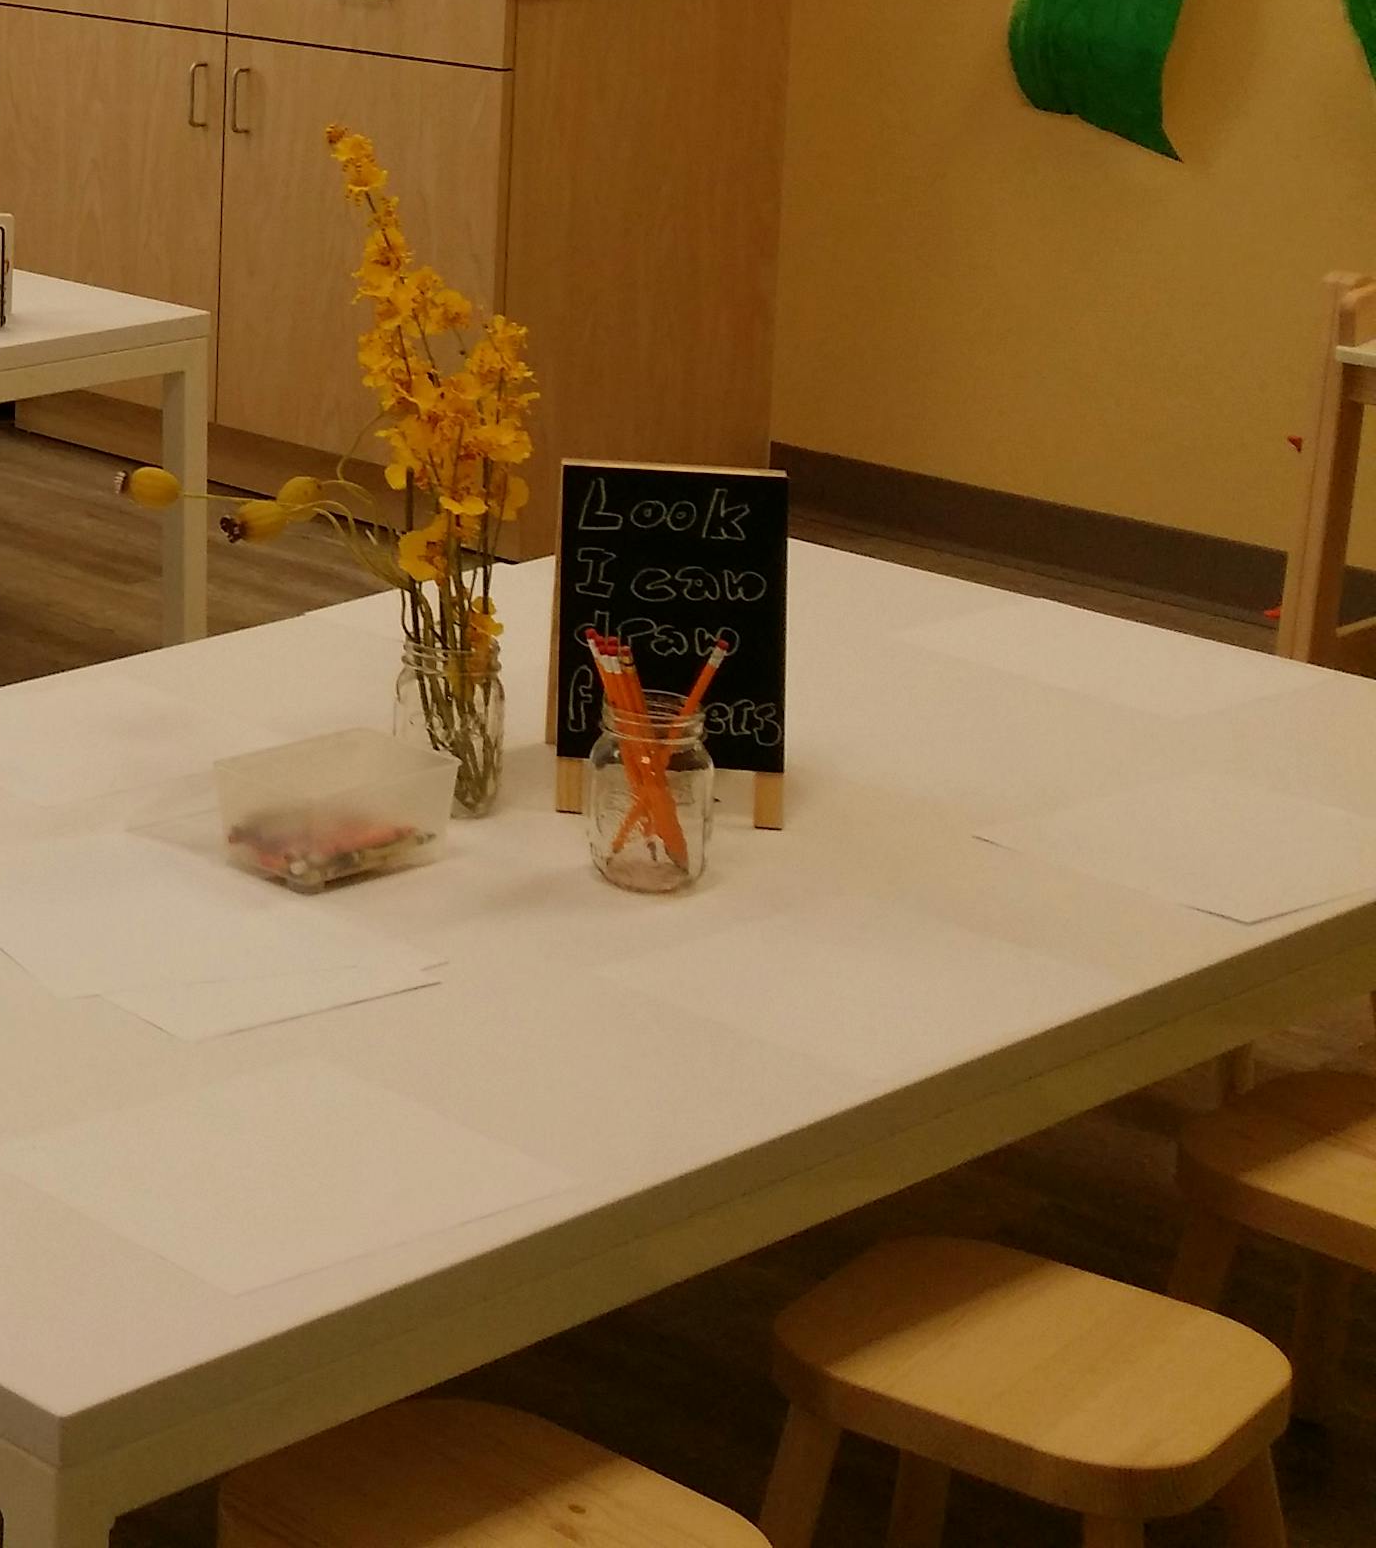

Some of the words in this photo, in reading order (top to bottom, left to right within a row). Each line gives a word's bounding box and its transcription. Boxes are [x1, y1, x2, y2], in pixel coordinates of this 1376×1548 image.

[578, 477, 751, 541] Look
[575, 547, 617, 599] I
[630, 566, 767, 602] can
[574, 610, 740, 656] draw
